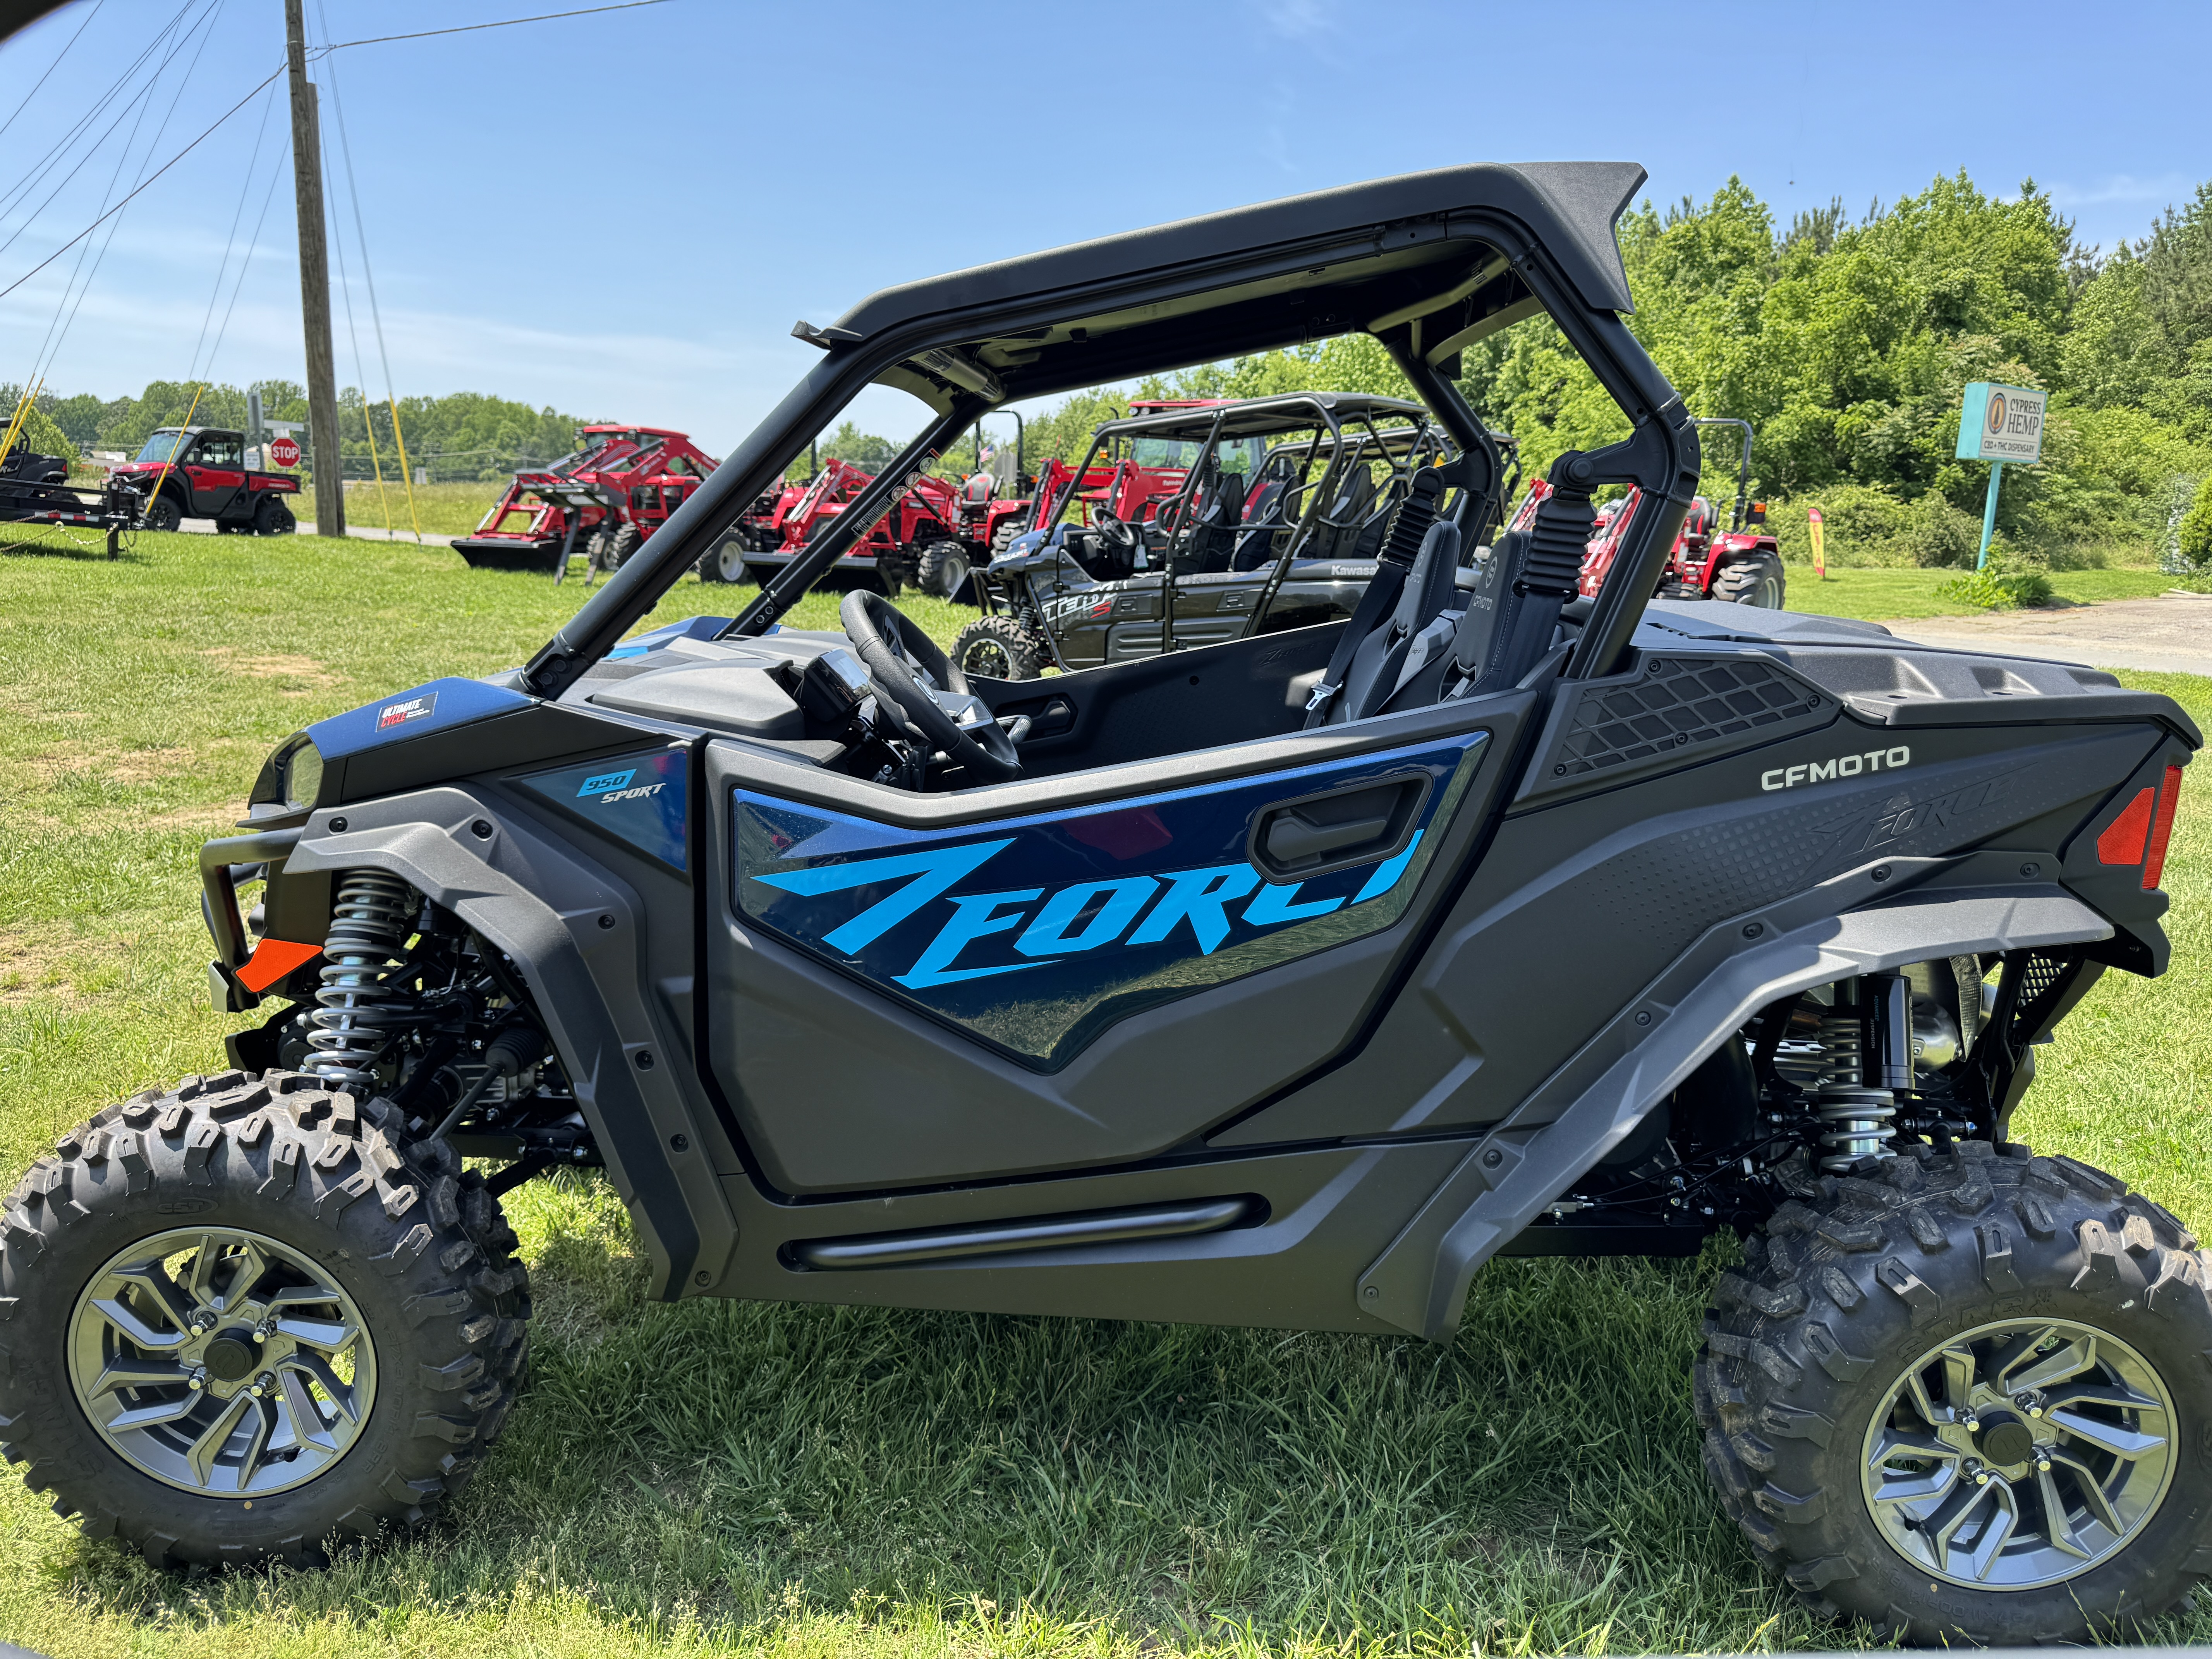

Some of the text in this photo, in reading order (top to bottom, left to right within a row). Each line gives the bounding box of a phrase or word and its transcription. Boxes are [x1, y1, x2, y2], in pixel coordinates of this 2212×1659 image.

[2010, 399, 2041, 414] CYPRESS
[2008, 413, 2039, 435] HEMP
[273, 446, 298, 459] STOP
[1998, 441, 2008, 451] THC
[2008, 443, 2034, 453] DISPENSARY
[382, 698, 423, 718] ULTIMATE
[381, 711, 408, 727] CYCLE
[1761, 746, 1910, 791] CFMOTO
[586, 775, 627, 791] 950
[600, 783, 667, 804] SPORT
[158, 1202, 203, 1213] CST
